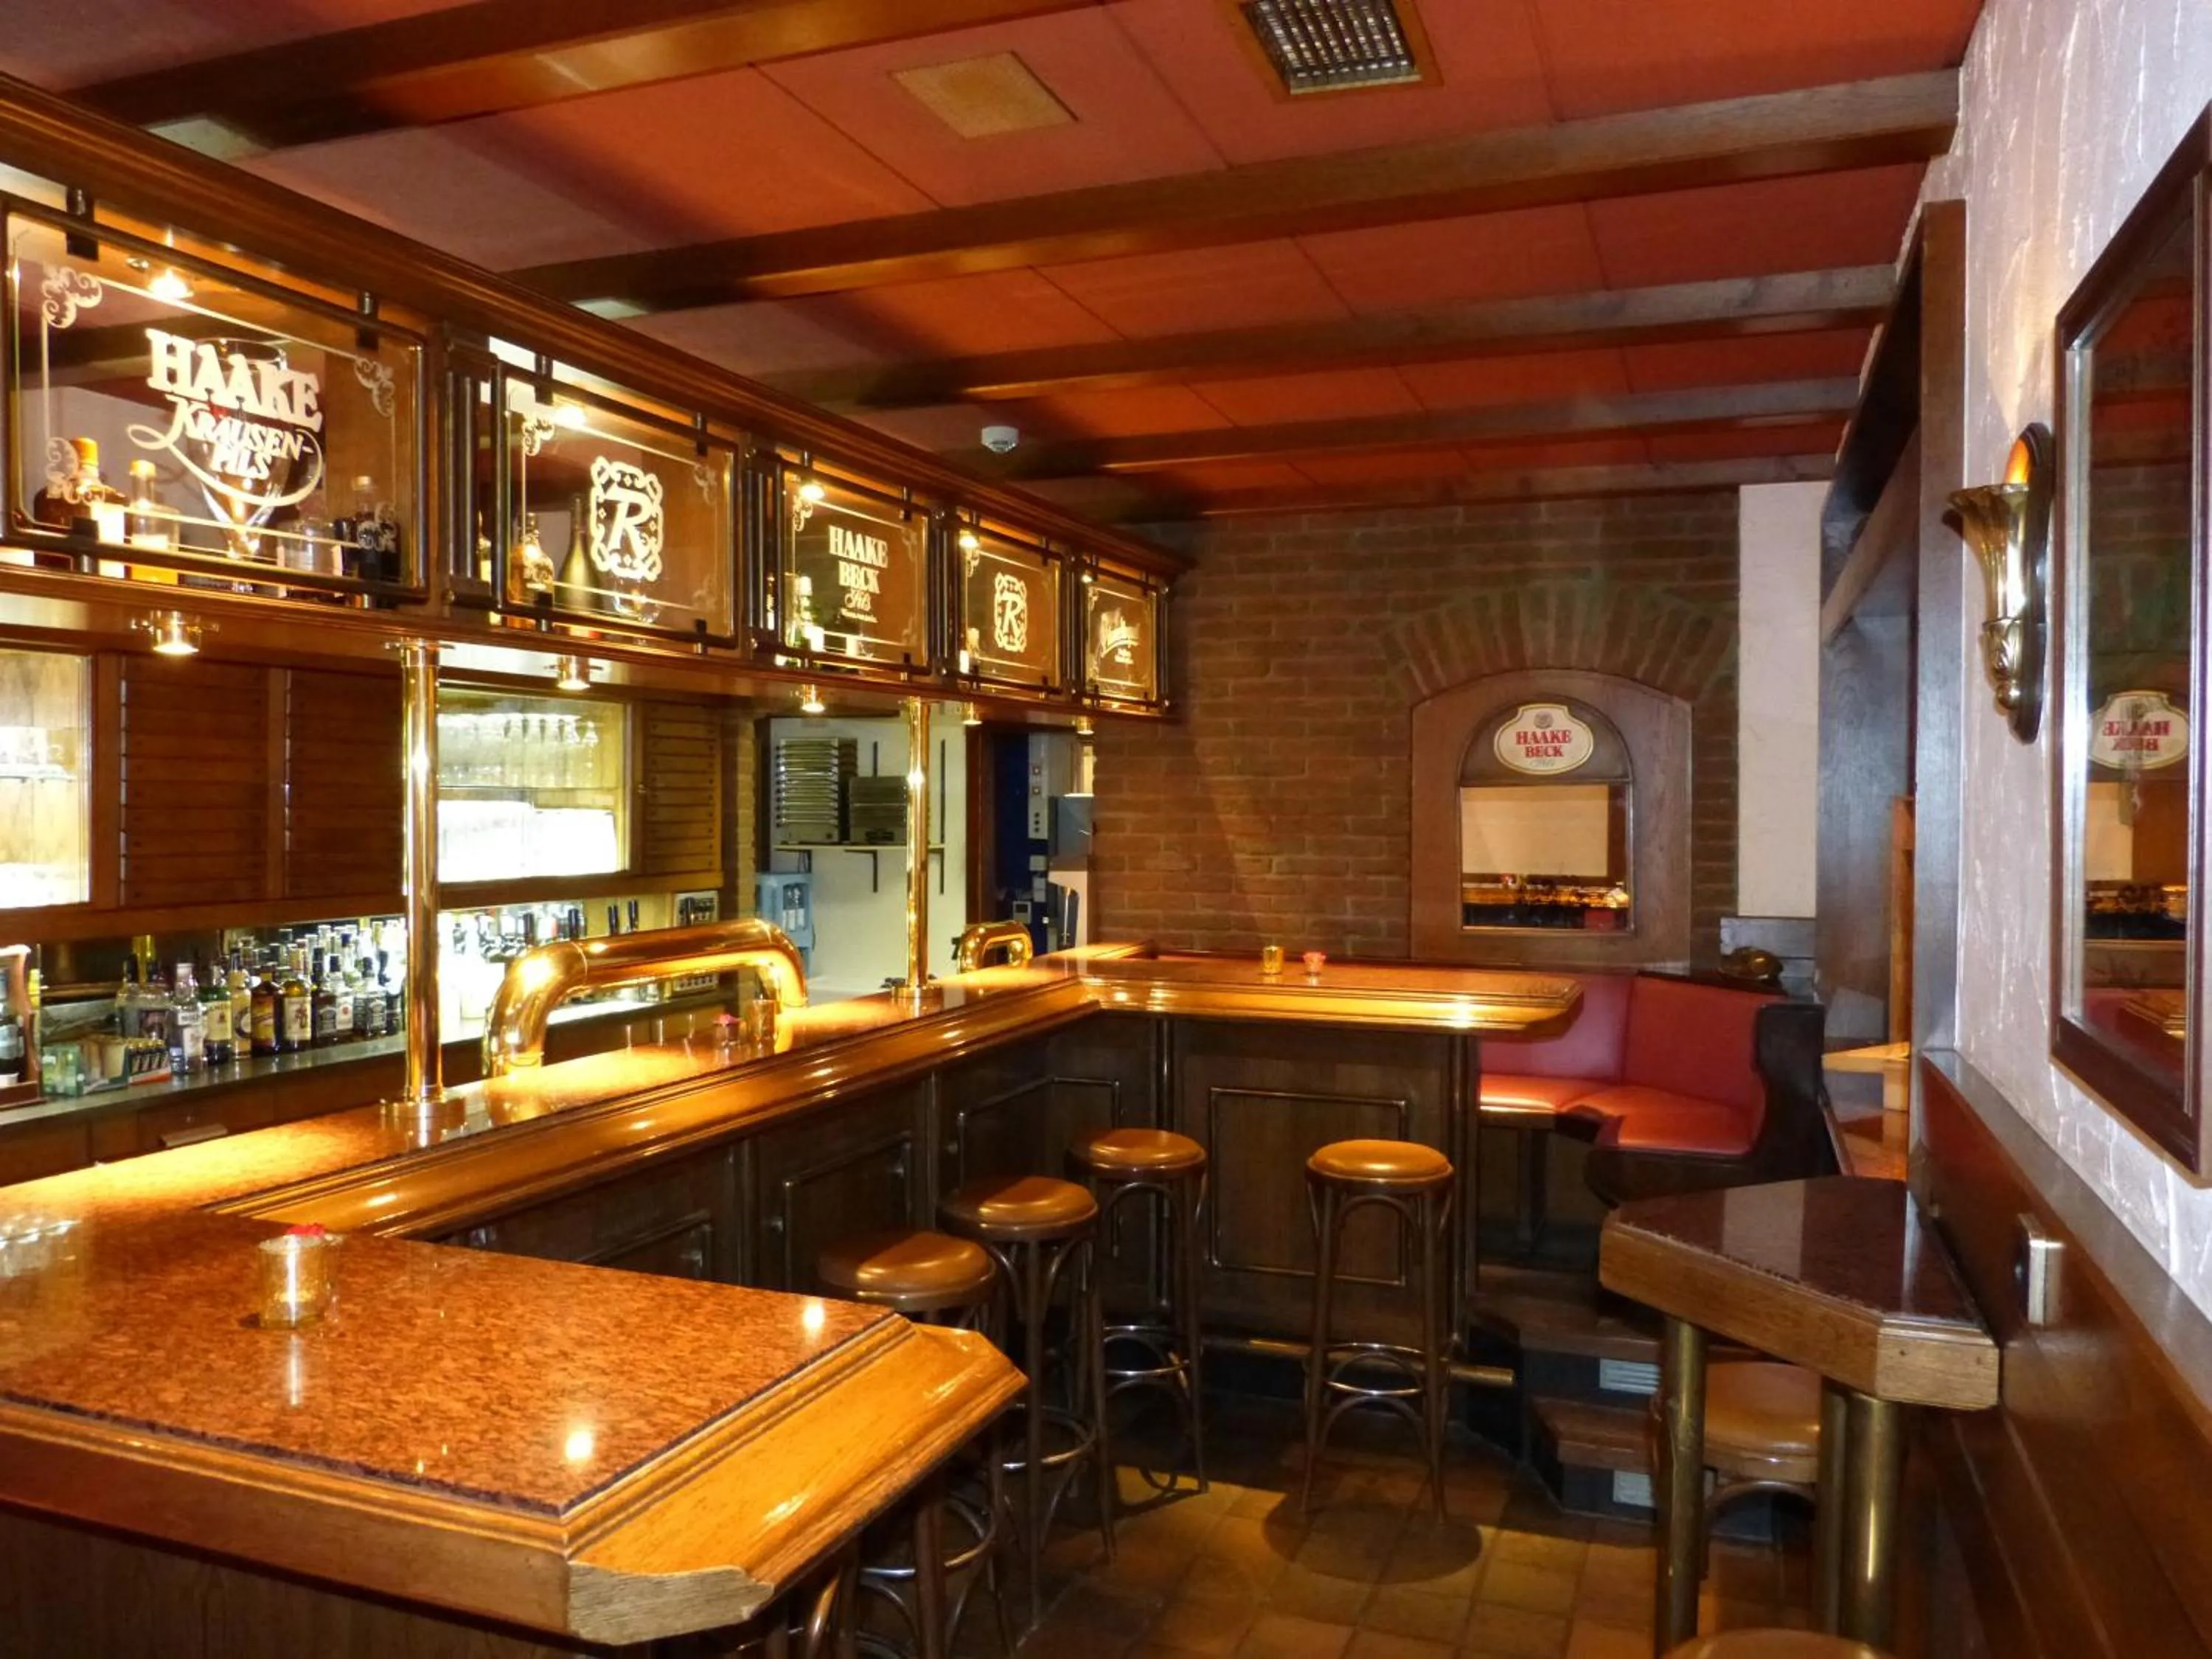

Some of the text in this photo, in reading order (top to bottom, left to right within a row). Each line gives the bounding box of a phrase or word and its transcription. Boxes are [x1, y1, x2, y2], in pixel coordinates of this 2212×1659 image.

[145, 328, 322, 432] HAAKE
[601, 483, 652, 562] R
[829, 524, 888, 568] HAAKE
[838, 560, 880, 594] BECK
[1515, 729, 1571, 745] HAAKE
[1525, 745, 1564, 758] BECK
